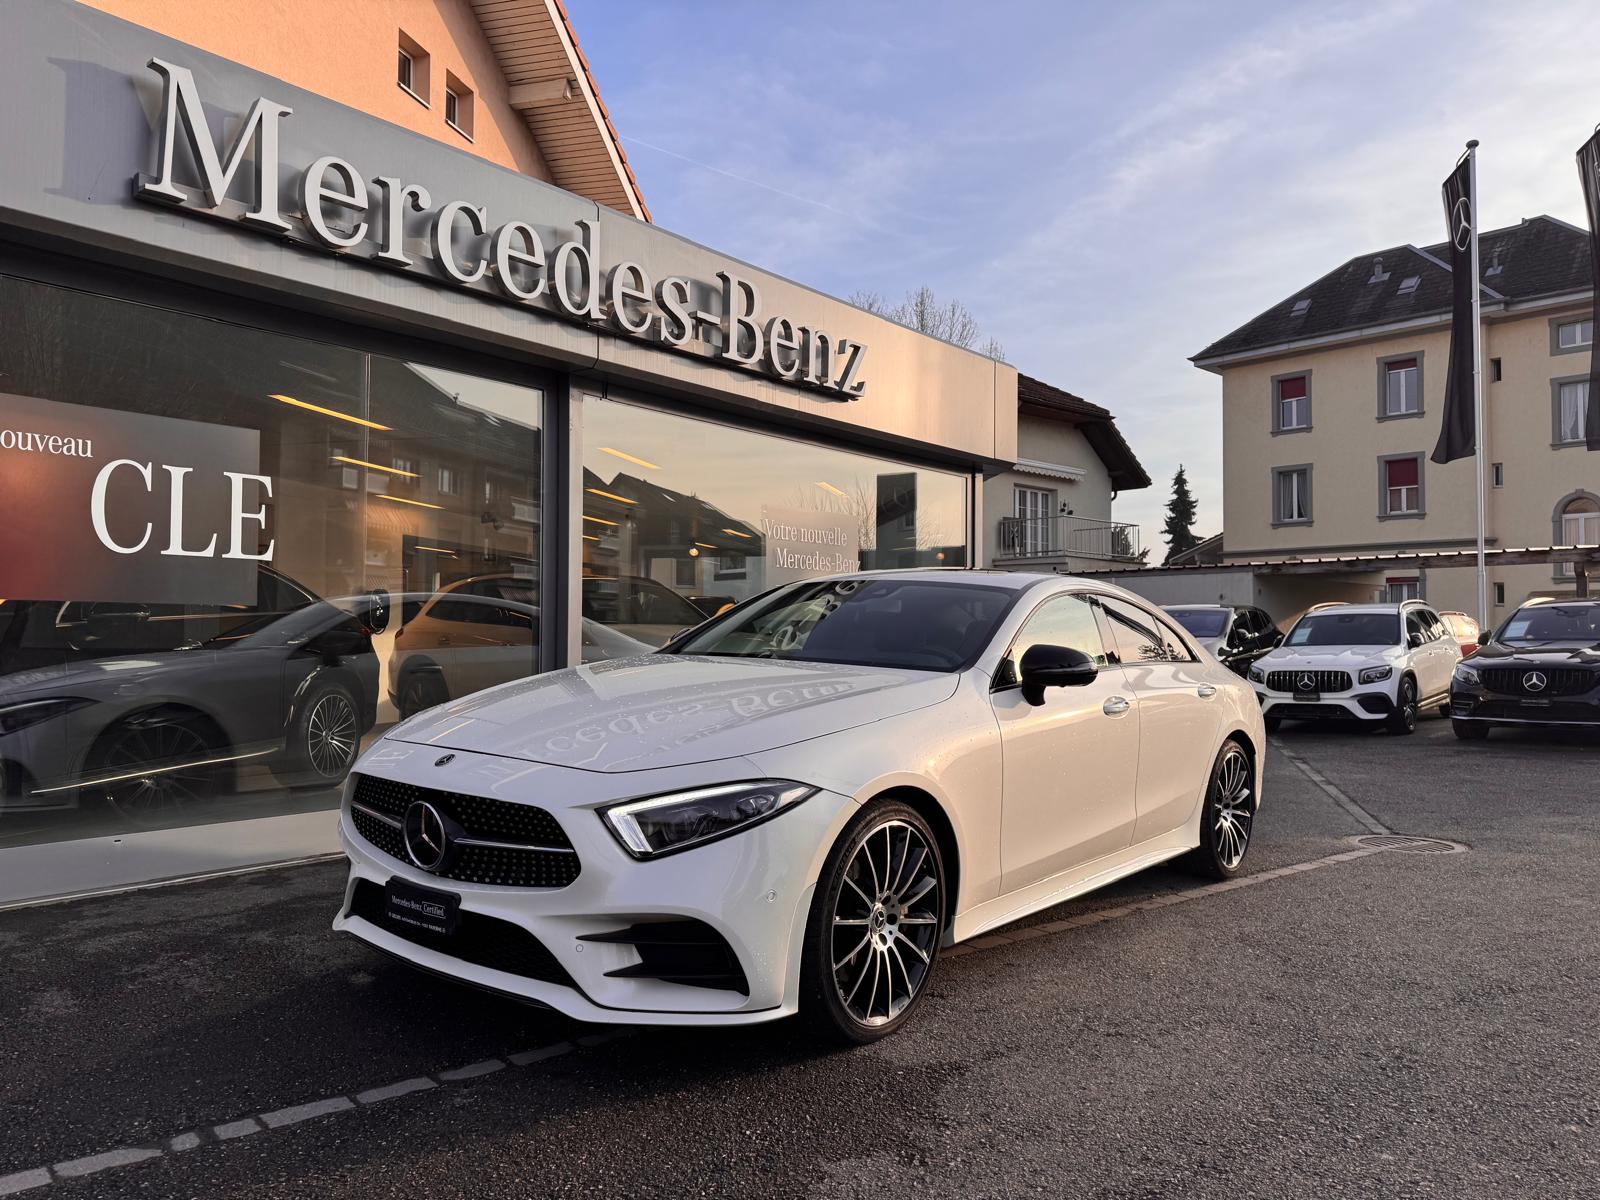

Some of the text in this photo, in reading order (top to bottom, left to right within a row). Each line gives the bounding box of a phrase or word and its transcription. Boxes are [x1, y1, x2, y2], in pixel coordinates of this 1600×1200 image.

[136, 57, 868, 401] Mercedes-Benz
[90, 458, 275, 562] CLE
[765, 518, 848, 546] Votre nouvelle
[775, 547, 861, 574] Mercedes-Benz
